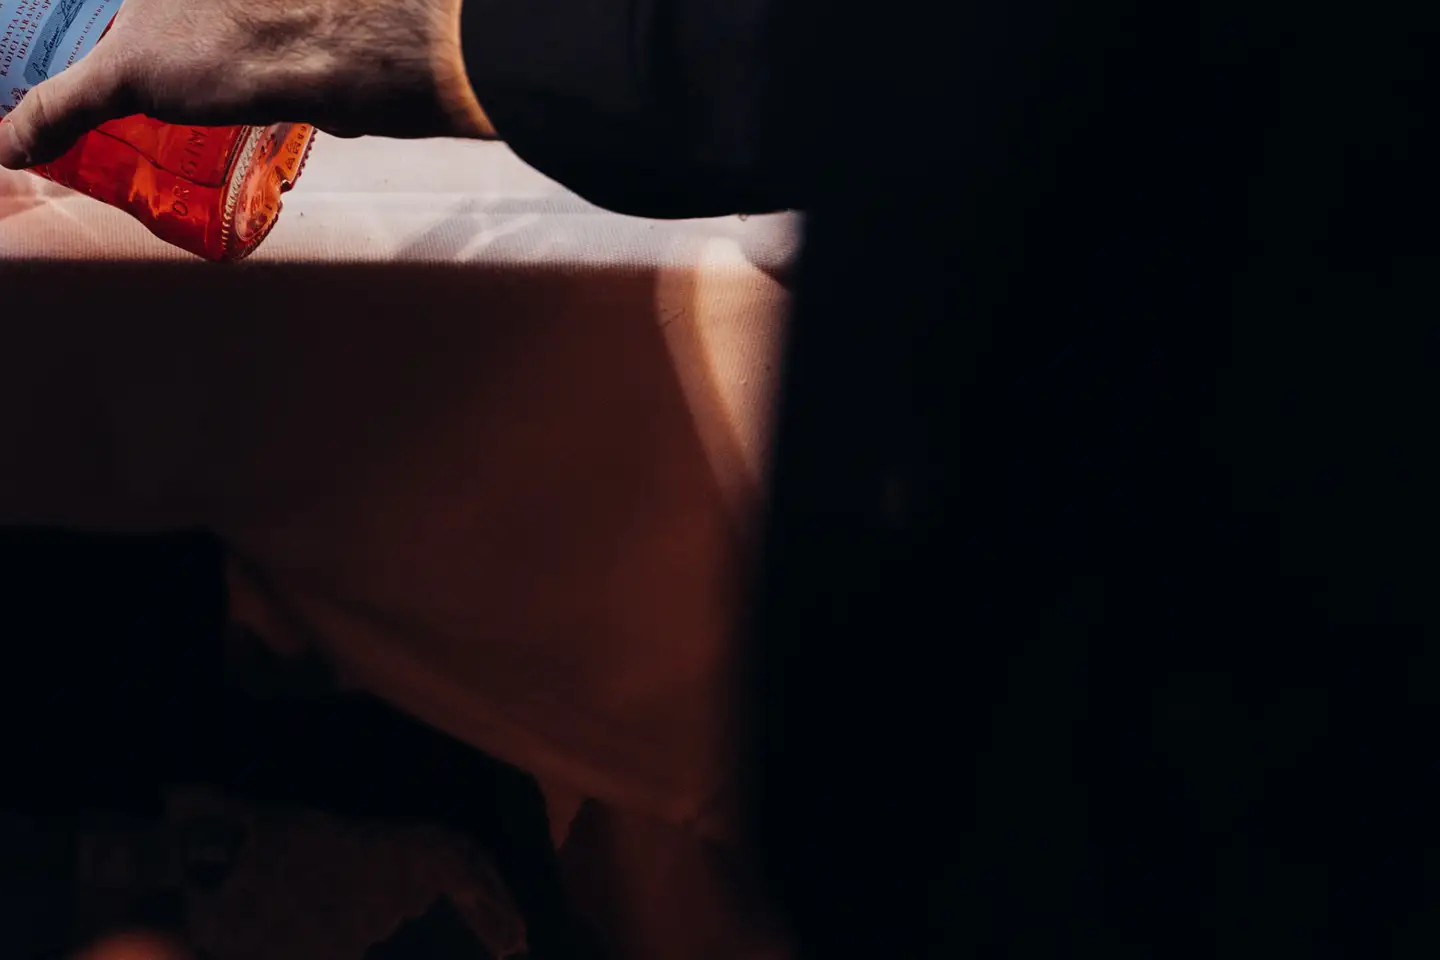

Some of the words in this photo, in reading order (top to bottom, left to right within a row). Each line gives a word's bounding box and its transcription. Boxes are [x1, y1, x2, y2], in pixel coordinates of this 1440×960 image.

[17, 22, 38, 60] IDEALE
[64, 36, 84, 70] IROLAMO
[172, 128, 207, 216] ORIGIN
